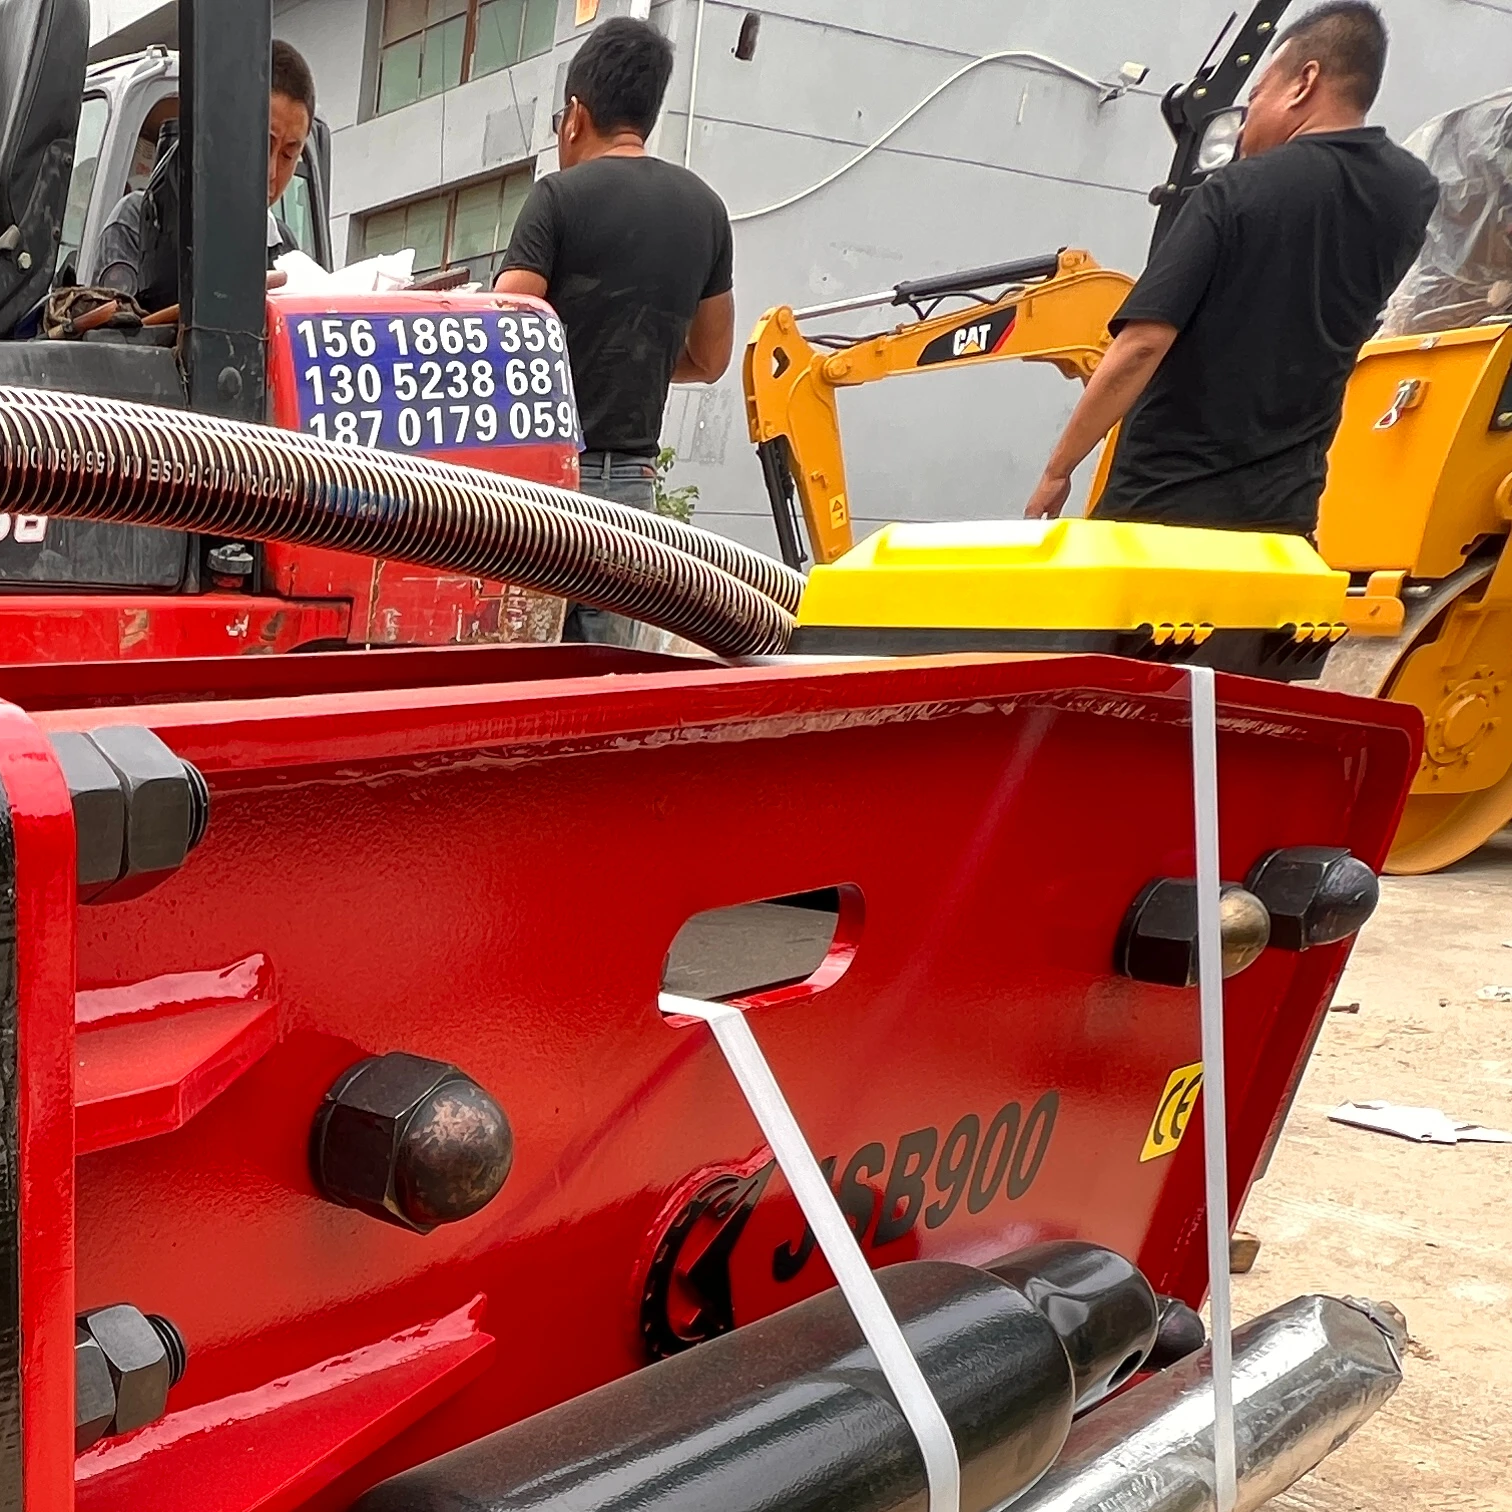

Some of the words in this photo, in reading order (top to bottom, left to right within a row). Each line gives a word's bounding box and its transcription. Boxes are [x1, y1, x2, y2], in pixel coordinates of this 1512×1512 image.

[297, 319, 376, 358] 156
[388, 317, 488, 356] 1865
[497, 316, 564, 353] 358
[953, 323, 992, 356] CAT
[304, 364, 382, 405] 130
[393, 359, 495, 400] 5238
[309, 409, 383, 449] 187
[398, 403, 498, 446] 0179
[1153, 1072, 1203, 1145] CE
